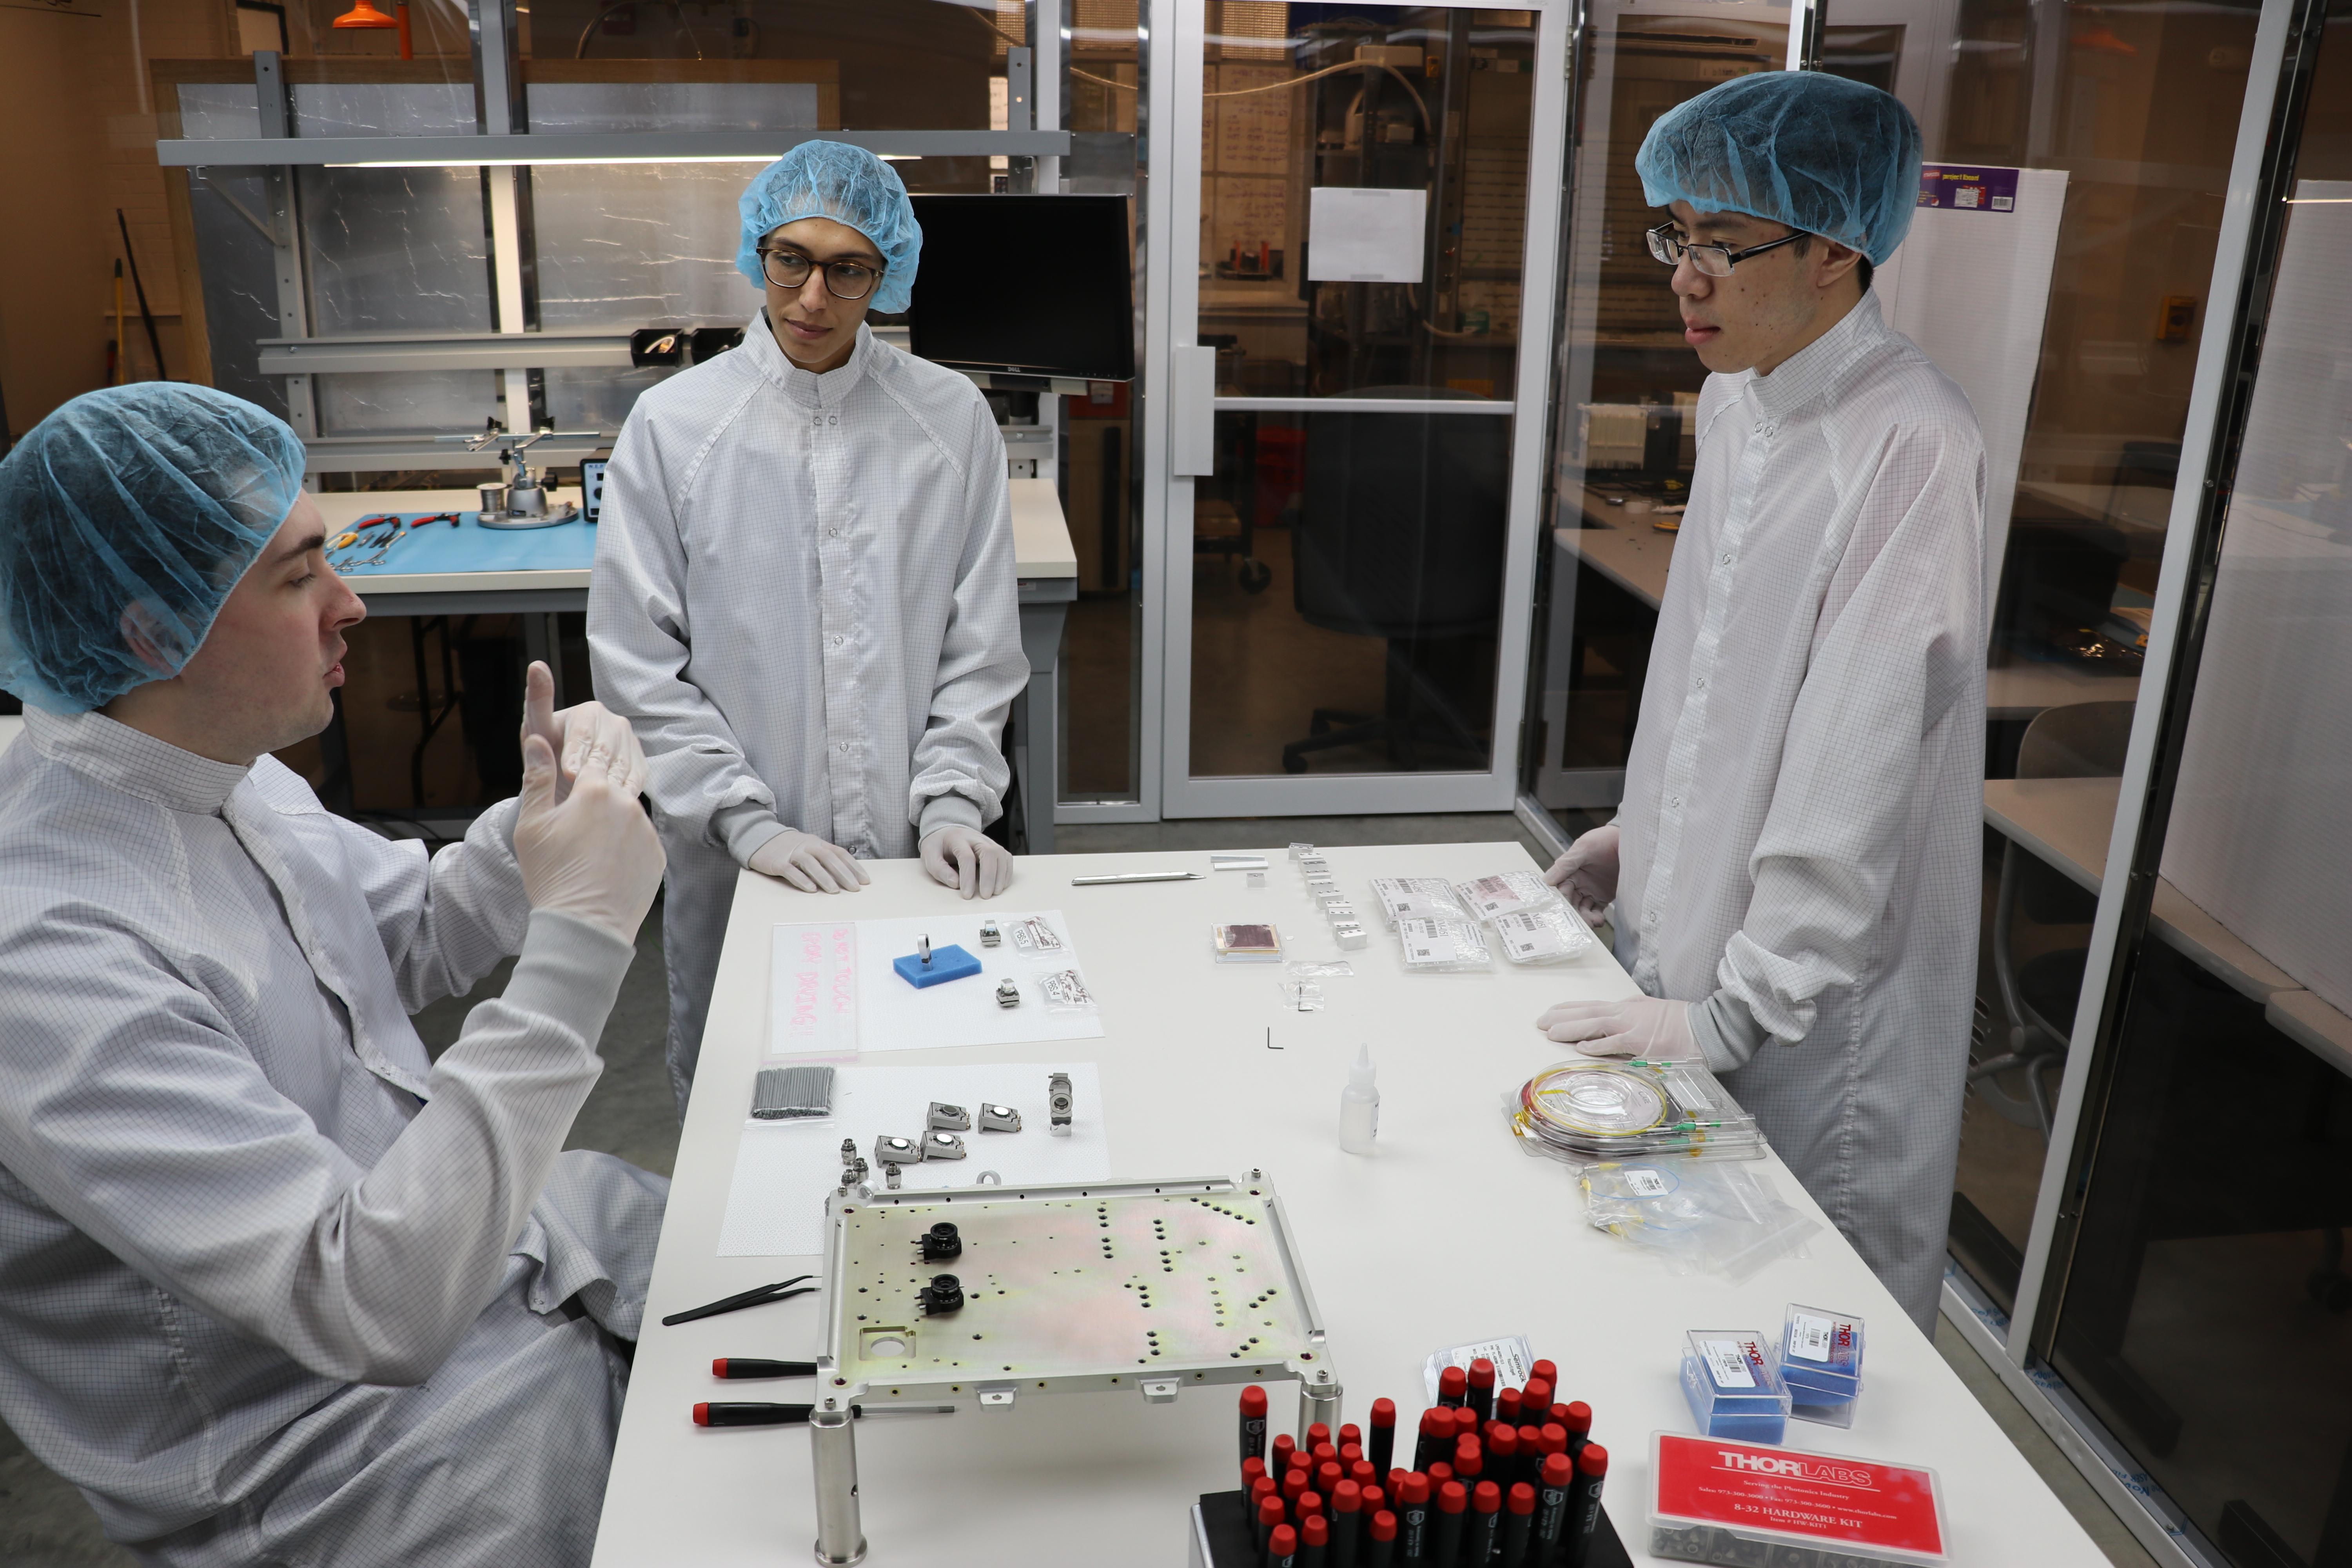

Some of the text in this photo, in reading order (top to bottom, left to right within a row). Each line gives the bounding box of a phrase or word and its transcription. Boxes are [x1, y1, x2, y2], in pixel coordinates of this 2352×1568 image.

[1015, 929, 1027, 942] PBS
[832, 966, 852, 1014] TOUCH
[1047, 980, 1058, 992] PBS
[1836, 1324, 1851, 1367] THORLABS
[1513, 1354, 1527, 1384] Semrock
[1737, 1340, 1760, 1387] www.thorlabs.com
[1744, 1341, 1775, 1387] THORLABS
[1718, 1451, 1872, 1486] THORLABS
[1717, 1489, 1764, 1500] 973-300-3000
[1785, 1498, 1831, 1509] 973-300-3600
[1837, 1506, 1897, 1520] www.thorlabs.com
[1744, 1480, 1770, 1489] Serving
[1784, 1485, 1818, 1495] Photonics
[1820, 1491, 1849, 1501] Industry
[1734, 1503, 1863, 1528] 8-32 HARDWARE KIT
[1793, 1519, 1827, 1529] HW-KIT1
